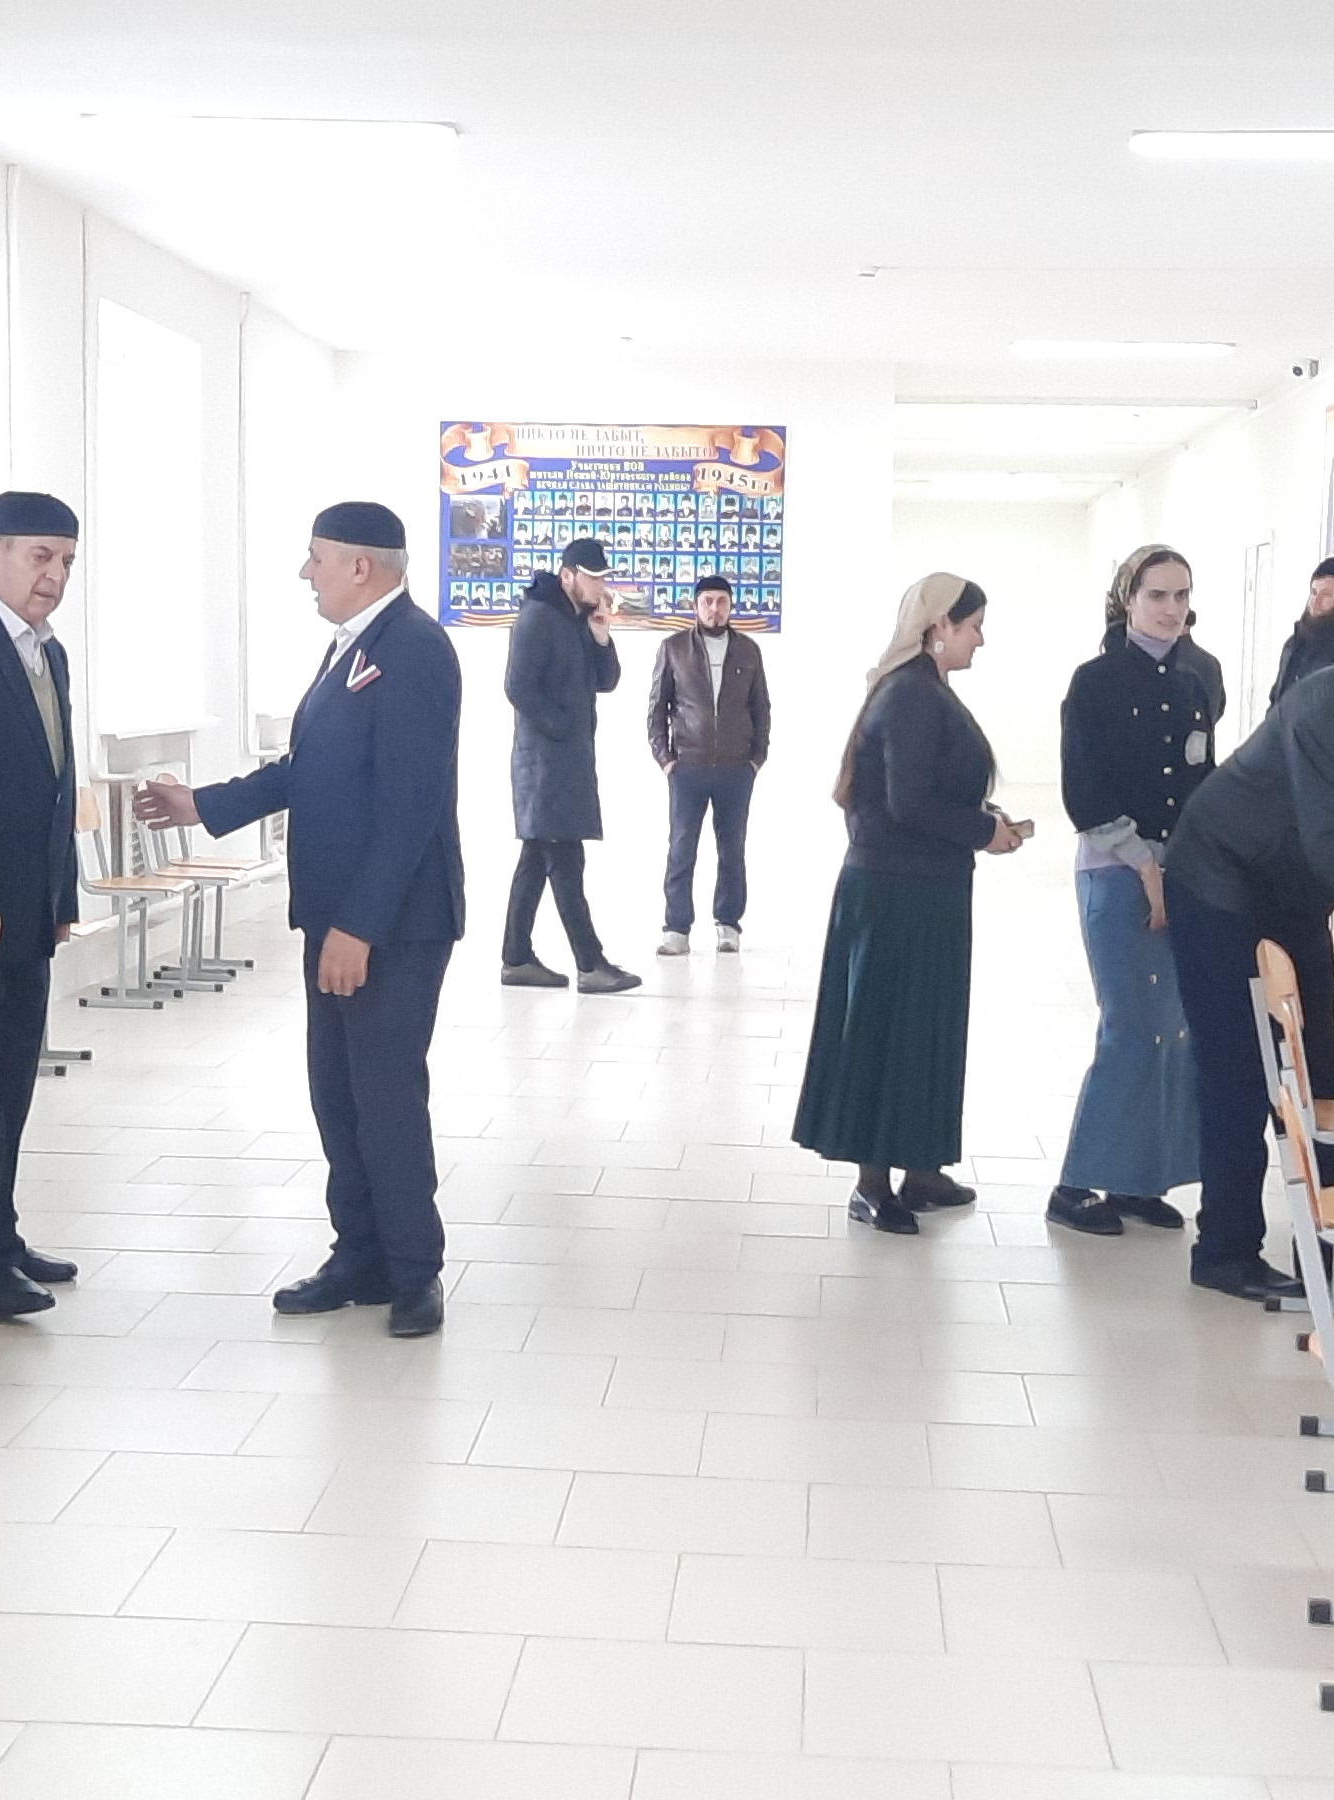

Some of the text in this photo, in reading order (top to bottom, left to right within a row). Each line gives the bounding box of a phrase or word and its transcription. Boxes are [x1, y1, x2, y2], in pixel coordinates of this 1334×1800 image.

[515, 427, 565, 440] НИКТО
[570, 428, 588, 441] НЕ
[575, 444, 625, 457] НИЧТО
[630, 445, 648, 457] НЕ
